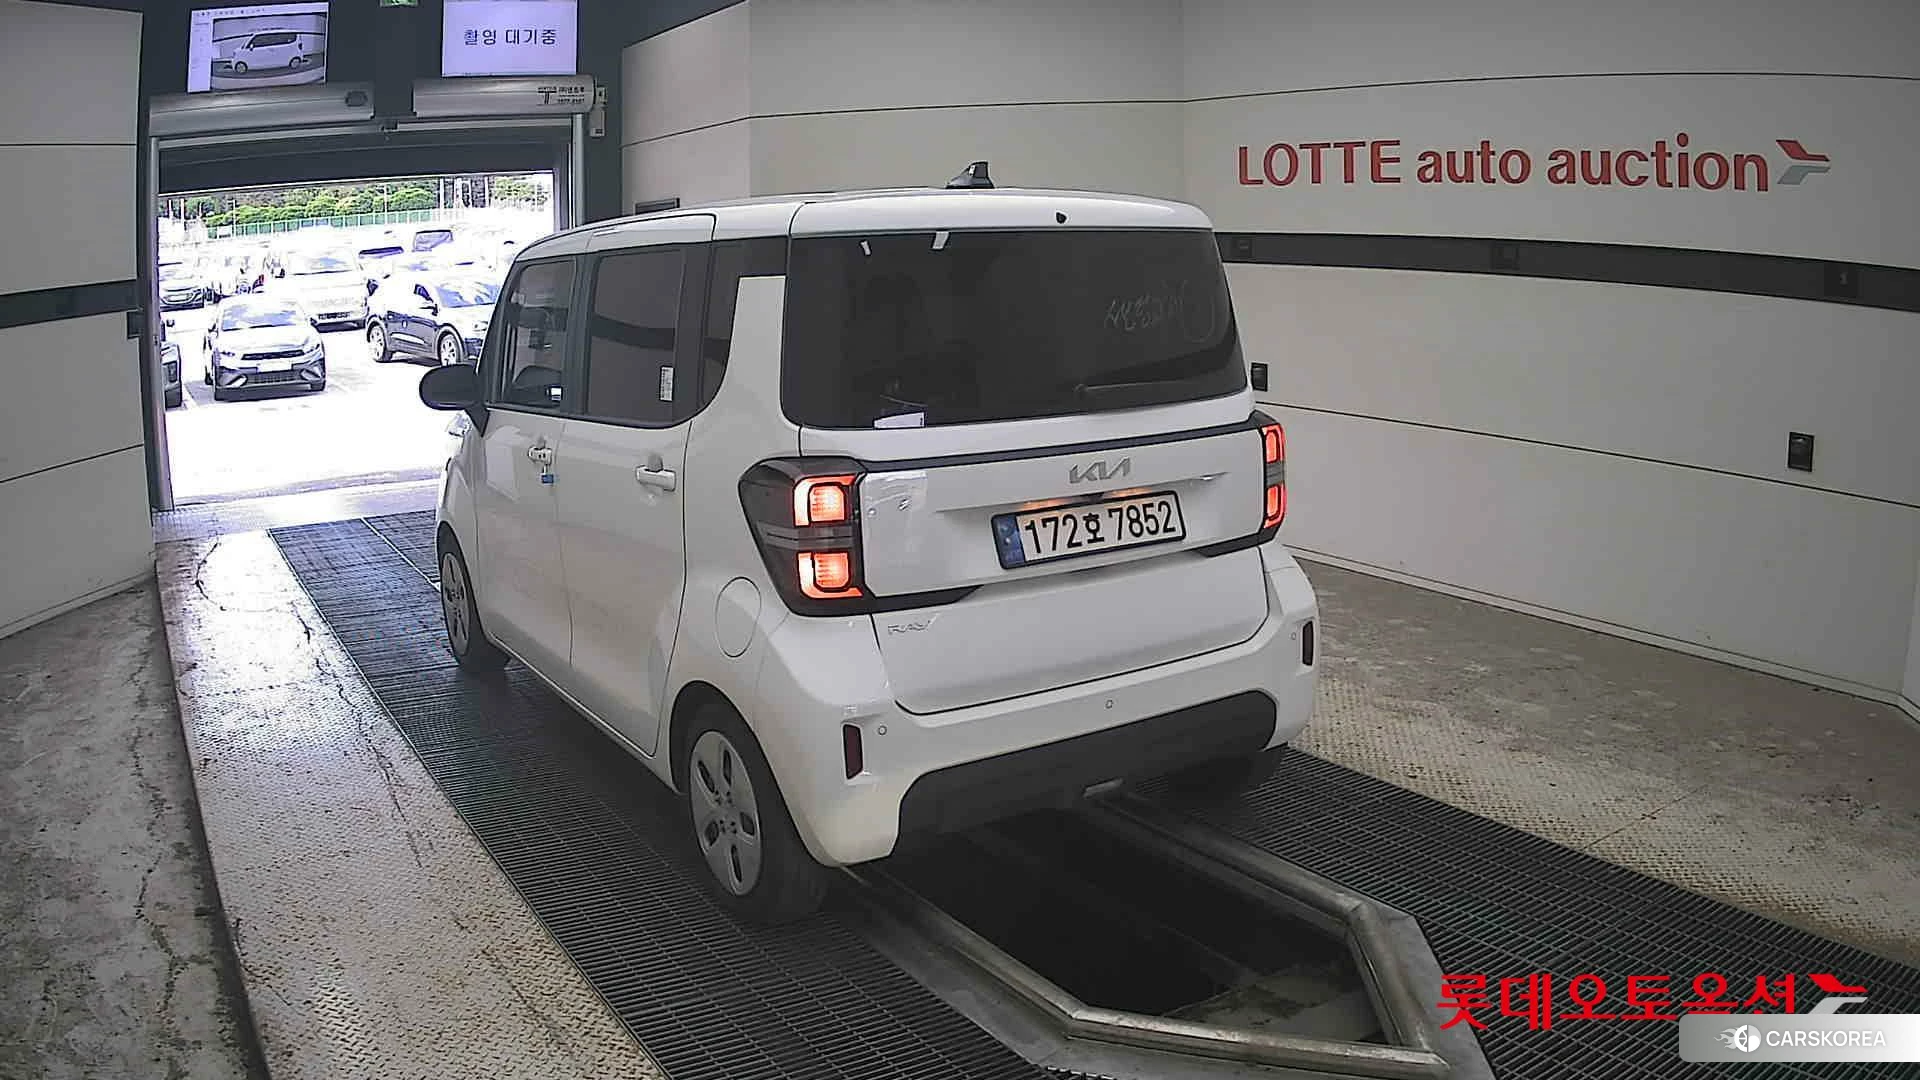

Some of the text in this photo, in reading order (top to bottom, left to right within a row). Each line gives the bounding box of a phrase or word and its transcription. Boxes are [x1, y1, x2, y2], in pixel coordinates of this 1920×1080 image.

[505, 29, 556, 45] 대기중
[1238, 132, 1770, 193] LOTTE auto auction
[1024, 500, 1177, 555] 172호 7852
